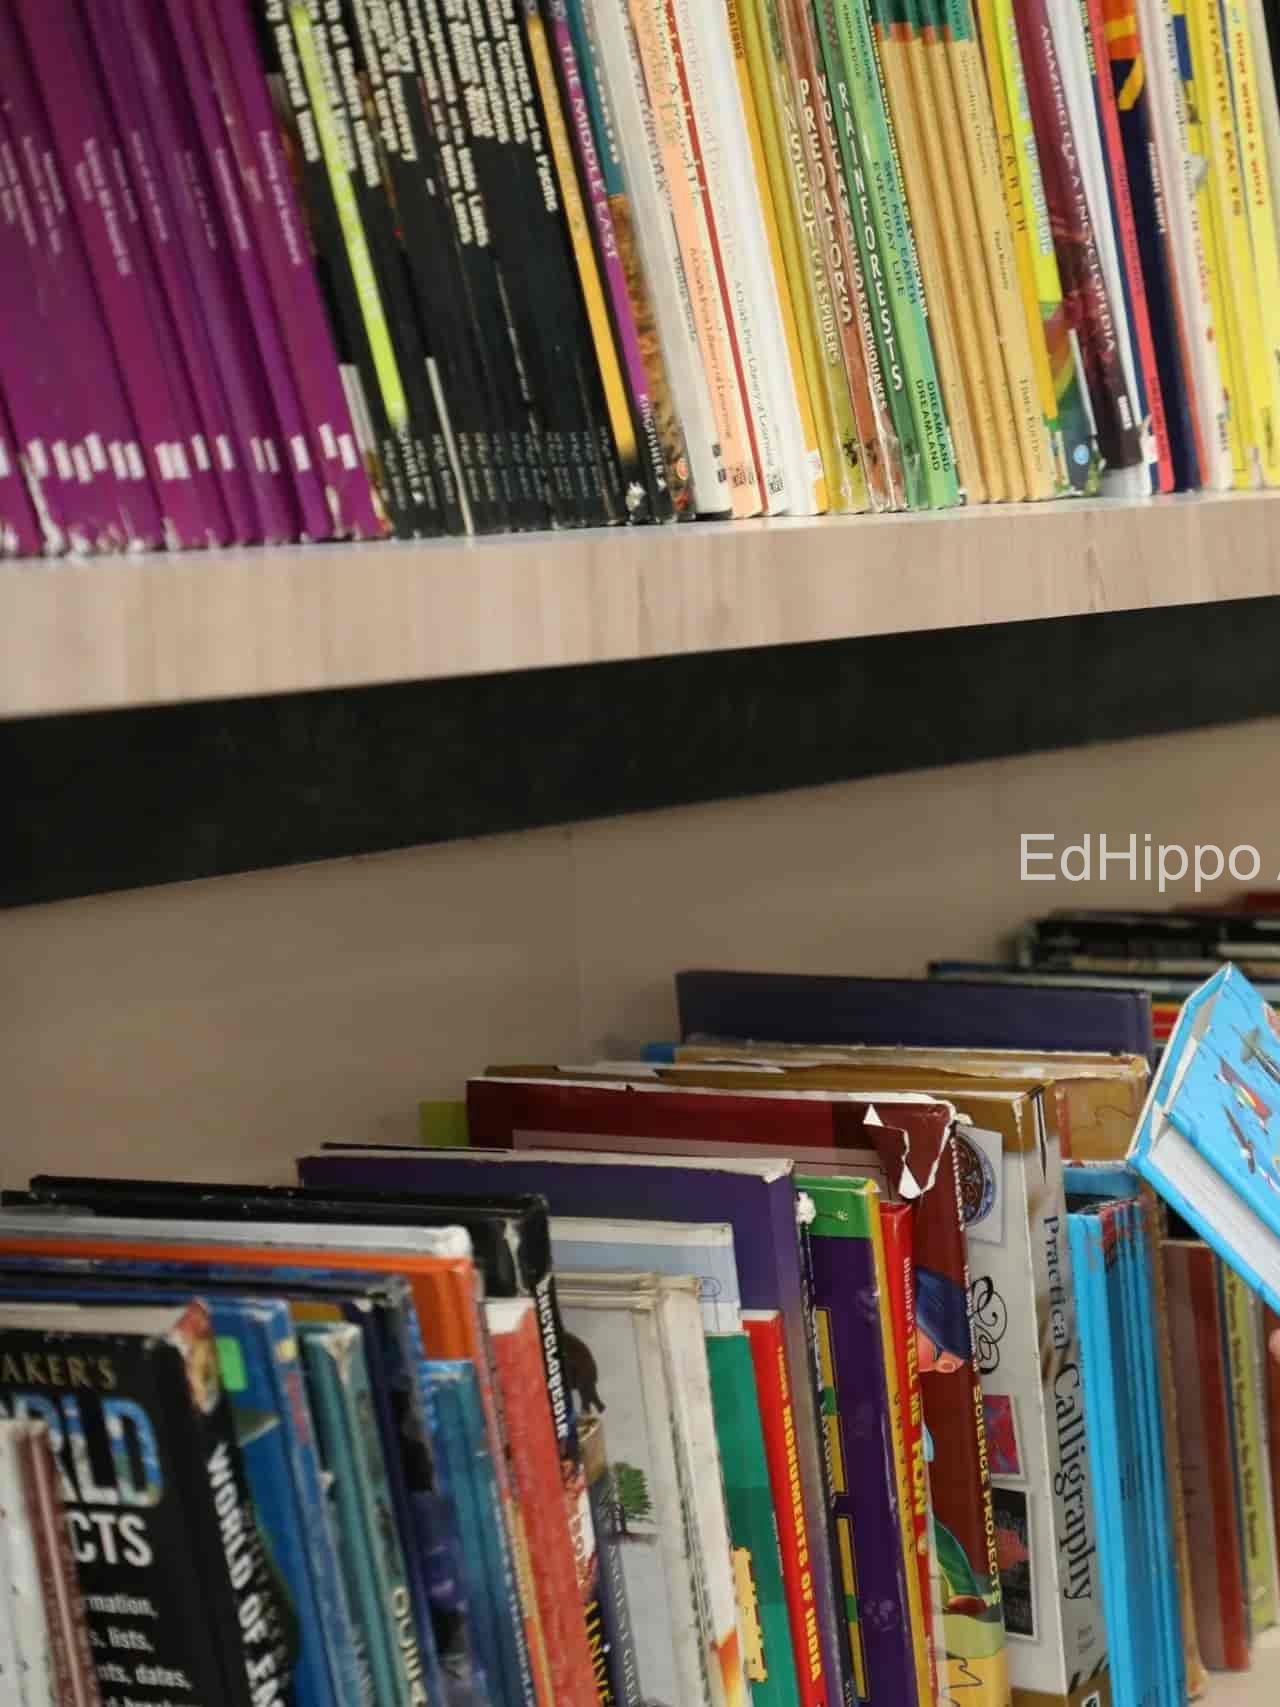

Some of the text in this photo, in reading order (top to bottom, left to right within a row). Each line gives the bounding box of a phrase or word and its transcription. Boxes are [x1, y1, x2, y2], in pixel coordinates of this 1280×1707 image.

[570, 95, 605, 193] MIDDLE
[594, 199, 622, 263] EAST
[798, 77, 853, 323] PREDATORS
[838, 81, 904, 392] RAINFORESTS
[816, 293, 840, 363] SPIDERS
[868, 161, 898, 252] EVERYDAY
[889, 260, 906, 298] LIFE
[913, 379, 942, 472] DREAMLAND
[881, 160, 896, 194] SKY
[889, 202, 905, 239] AND
[897, 246, 919, 304] EARTH
[924, 380, 953, 474] DREAMLAND
[1073, 192, 1117, 353] ENCYCLOPEDIA
[905, 1331, 920, 1390] TELL
[909, 1391, 922, 1426] ME
[1043, 1215, 1097, 1602] Practical Calligraphy
[63, 1511, 152, 1568] CTS
[206, 1442, 253, 1591] WORLD
[237, 1593, 270, 1645] OF
[782, 1404, 808, 1567] MONUMENTS
[972, 1384, 988, 1485] SCIENCE
[981, 1487, 1000, 1606] PROJECTS
[801, 1572, 814, 1602] OF
[804, 1606, 823, 1682] INDIA
